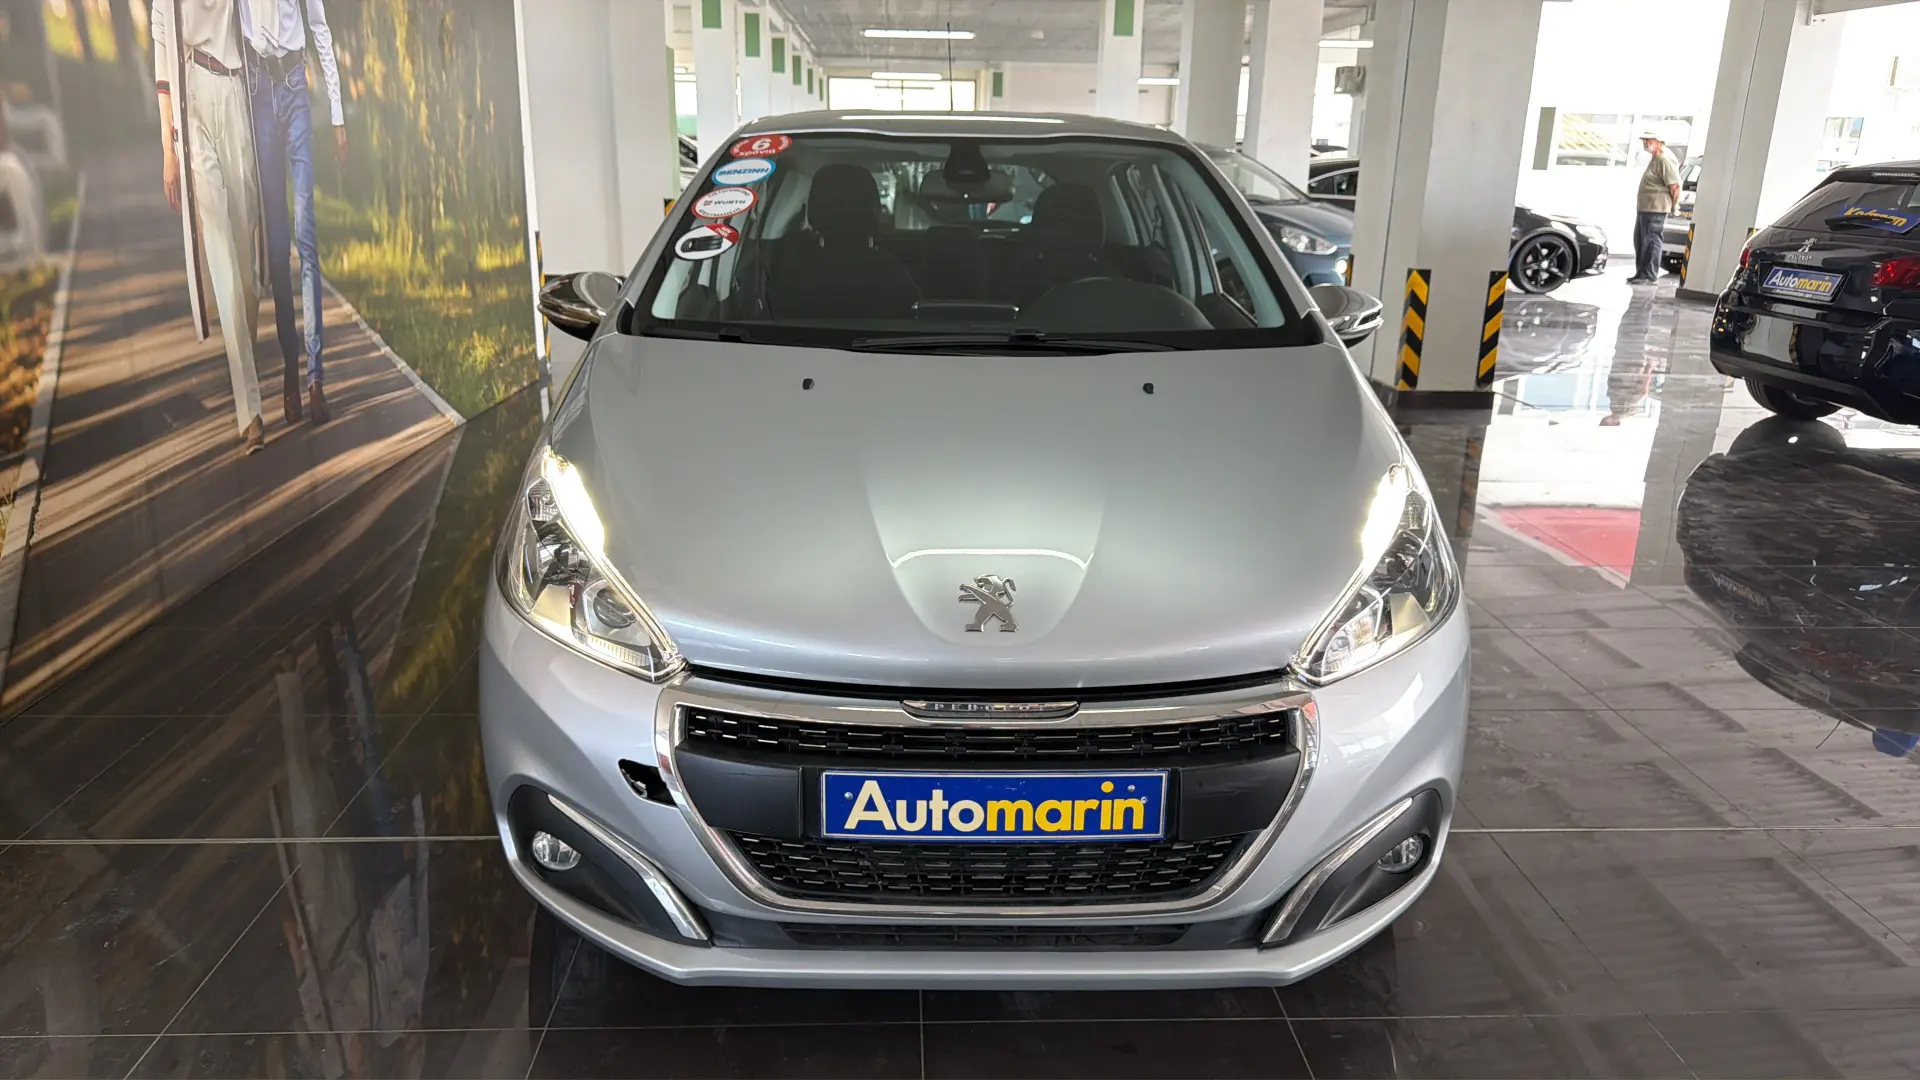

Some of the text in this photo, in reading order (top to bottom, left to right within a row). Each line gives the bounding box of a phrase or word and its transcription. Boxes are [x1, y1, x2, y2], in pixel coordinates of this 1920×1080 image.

[752, 137, 772, 151] 6
[1769, 270, 1832, 293] Automarin
[844, 780, 1144, 832] Automarin
